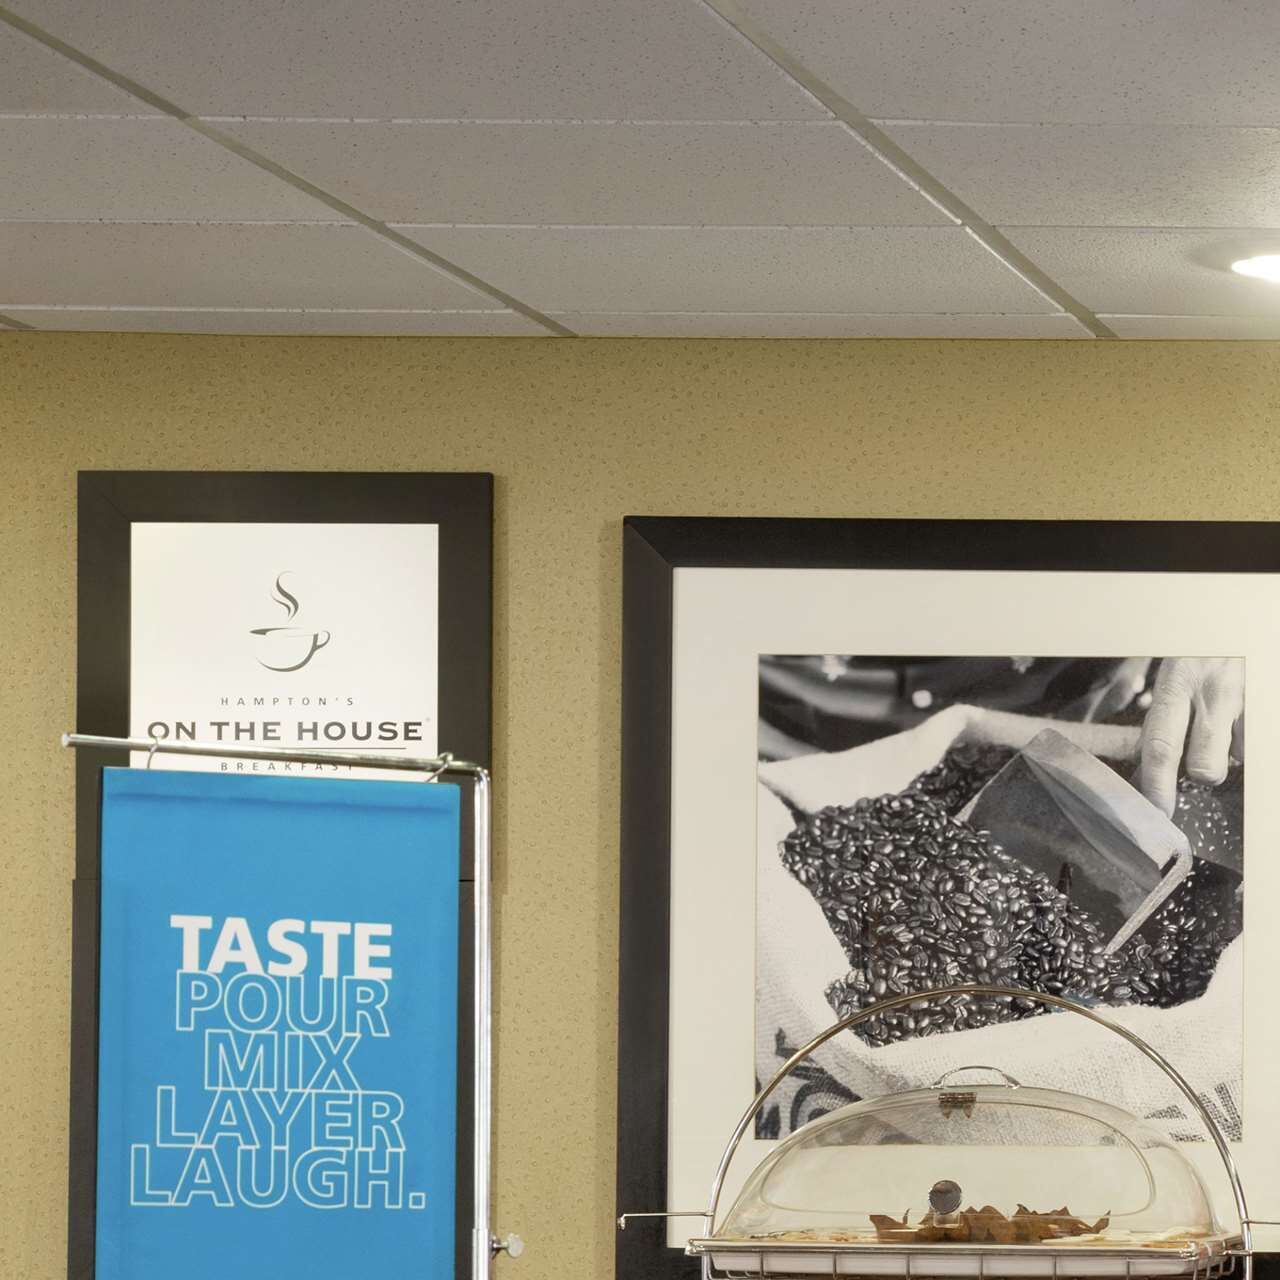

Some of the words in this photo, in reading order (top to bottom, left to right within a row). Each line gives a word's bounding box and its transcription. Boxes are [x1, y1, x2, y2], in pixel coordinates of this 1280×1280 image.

[147, 721, 196, 741] ON
[209, 721, 281, 741] THE
[297, 721, 422, 741] HOUSE
[220, 697, 354, 706] HAMPTON'S
[170, 914, 393, 980] TASTE
[175, 969, 390, 1038] POUR
[204, 1029, 361, 1092] MIX
[156, 1085, 406, 1152] LAYER
[130, 1143, 426, 1210] LAUGH.
